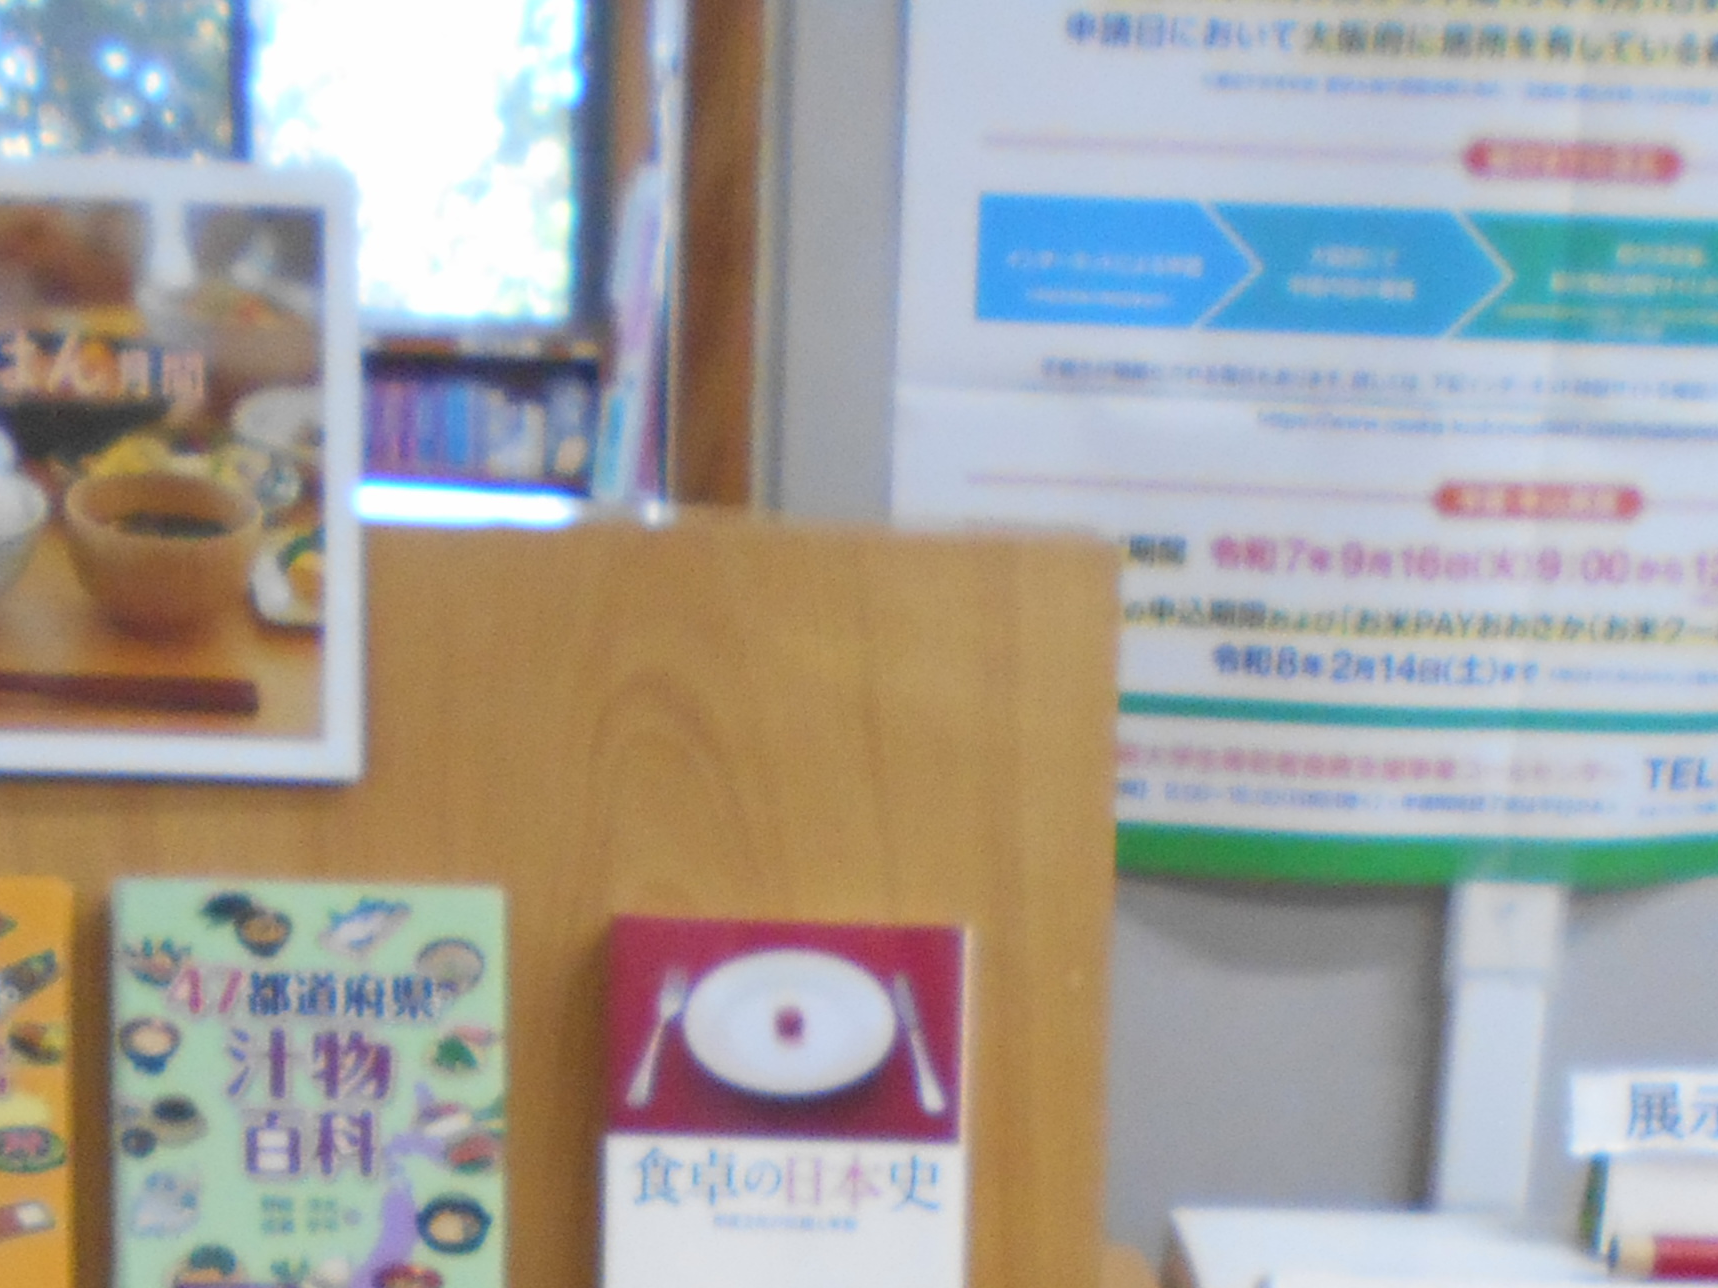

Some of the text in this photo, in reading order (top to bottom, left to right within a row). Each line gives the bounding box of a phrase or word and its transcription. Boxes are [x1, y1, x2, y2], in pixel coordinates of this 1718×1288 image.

[227, 1027, 391, 1100] 汁物
[244, 1110, 374, 1176] 百科
[633, 1145, 943, 1214] 食卓の日本史
